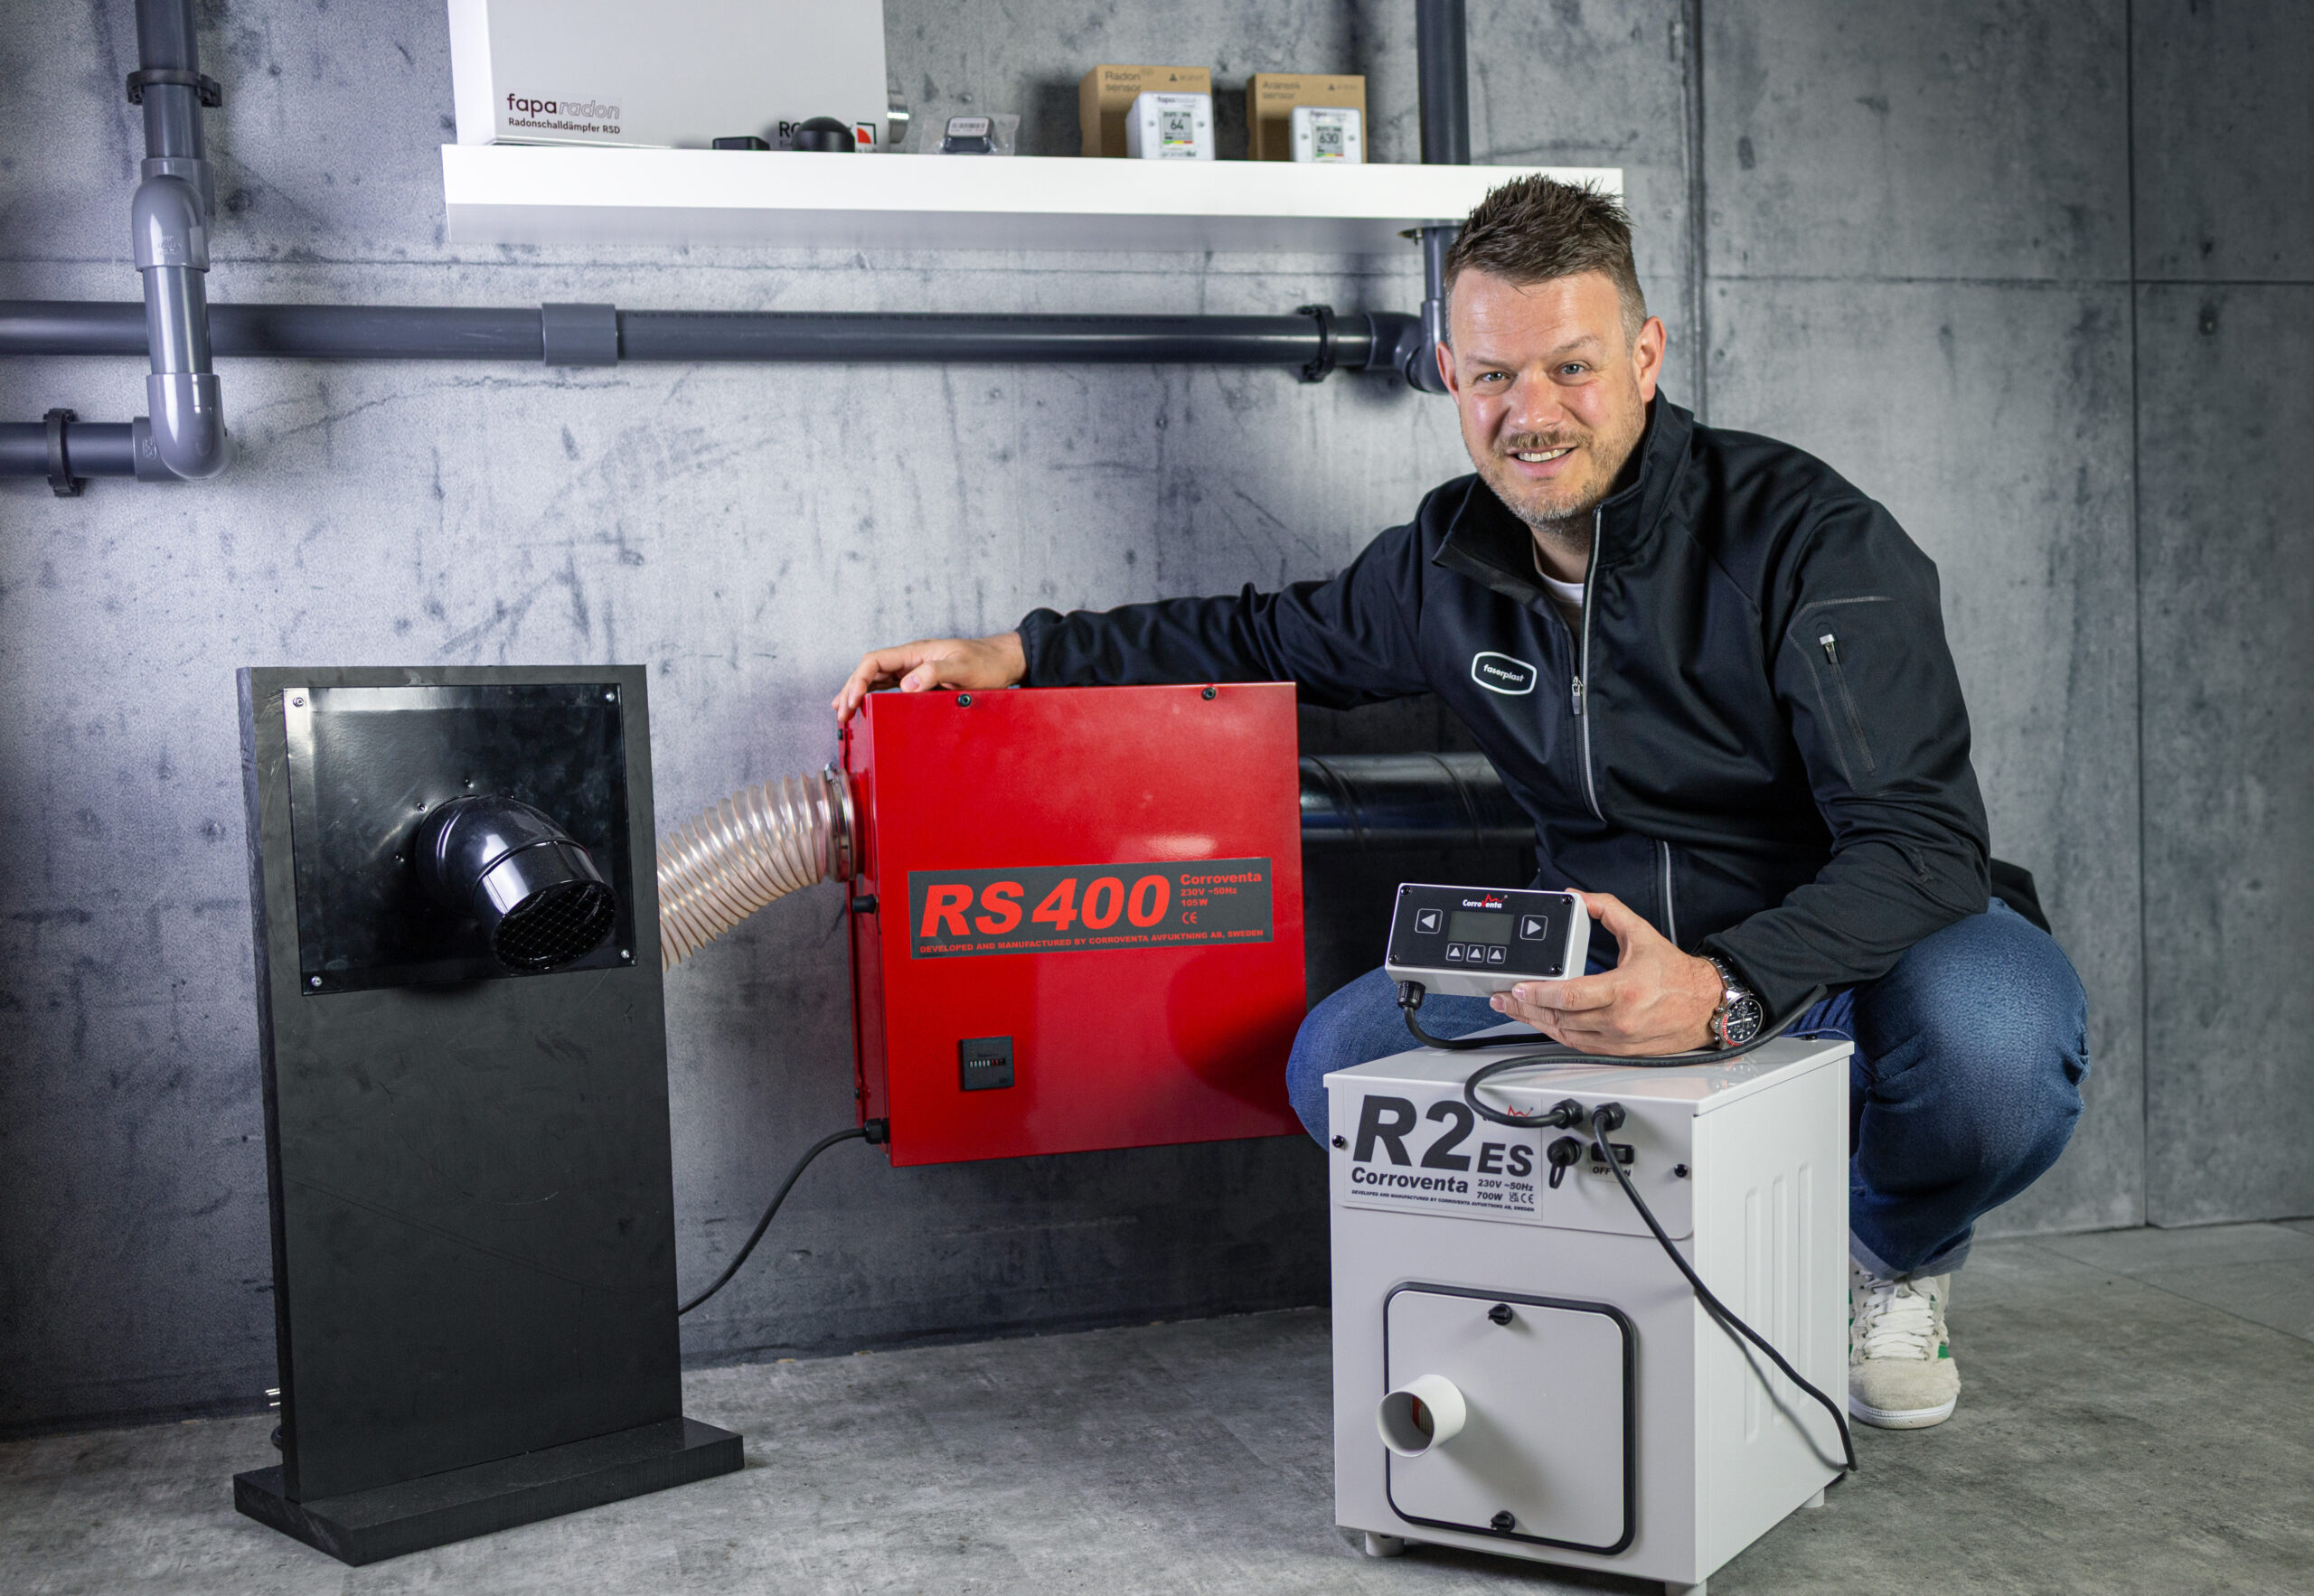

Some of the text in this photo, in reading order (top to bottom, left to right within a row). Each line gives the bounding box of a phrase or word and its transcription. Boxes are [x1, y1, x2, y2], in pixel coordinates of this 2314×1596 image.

[1105, 70, 1141, 80] Radon
[1105, 83, 1143, 91] sensor
[508, 117, 621, 135] Radonschalldämpfer RSD
[1170, 118, 1184, 130] 64
[1319, 132, 1340, 144] 630
[1483, 663, 1525, 682] faserplast
[1180, 871, 1262, 886] Corroventa
[1181, 888, 1205, 897] 230V
[1181, 898, 1208, 907] 105W
[919, 944, 974, 953] DEVELOPED
[976, 943, 995, 951] AND
[997, 938, 1071, 949] MANUFACTURED
[1089, 934, 1149, 945] CORROVENTA
[1151, 932, 1208, 942] AVFUKTNING
[1228, 929, 1264, 938] SWEDEN
[1592, 1166, 1613, 1175] OFF
[1351, 1166, 1469, 1194] Corroventa
[1477, 1178, 1502, 1188] 230V
[1390, 1193, 1429, 1202] MANUFACTURED
[1438, 1197, 1471, 1206] CORROVENTA
[1476, 1191, 1503, 1201] 700W
